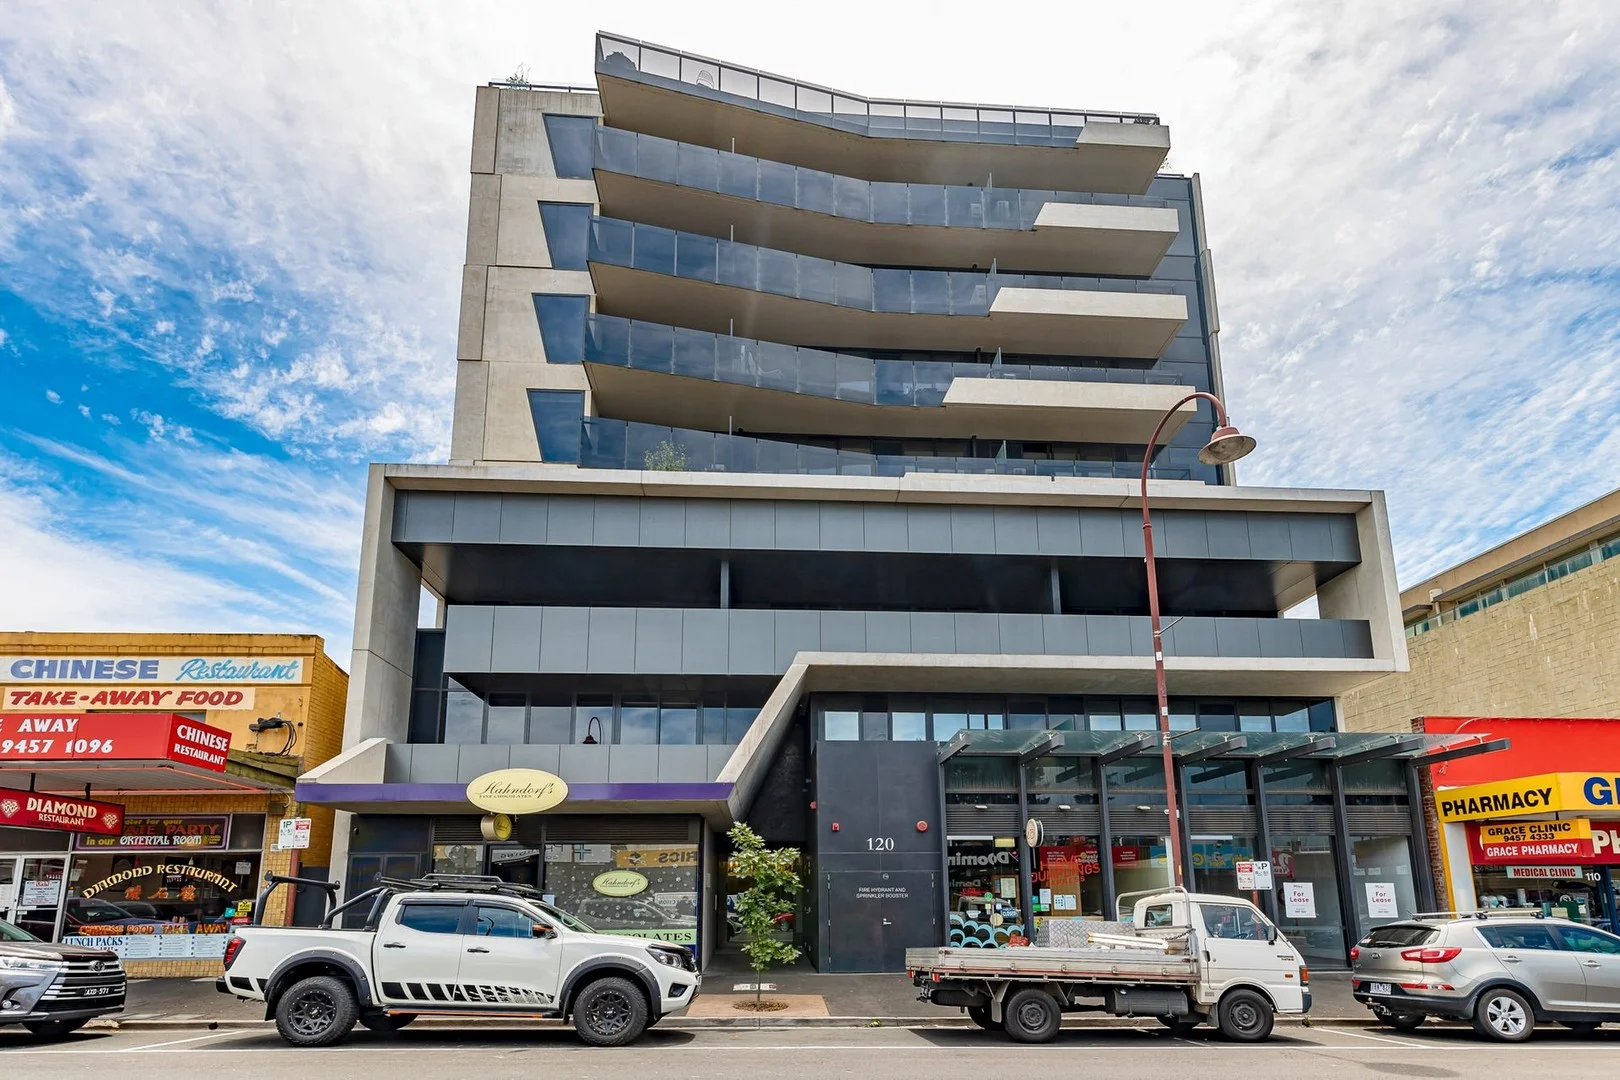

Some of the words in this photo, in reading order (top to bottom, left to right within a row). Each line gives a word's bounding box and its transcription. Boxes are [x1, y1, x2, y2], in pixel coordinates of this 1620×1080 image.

[10, 659, 159, 680] CHINESE
[175, 658, 299, 681] Restaurant
[10, 690, 173, 706] TAKE-AWAY
[175, 690, 244, 706] FOOD
[17, 718, 79, 733] AWAY
[176, 724, 229, 752] CHINESE
[1, 739, 54, 754] 9457
[65, 739, 114, 754] 1096
[173, 743, 225, 766] RESTAURANT
[474, 781, 554, 799] Hahndorf's
[26, 797, 98, 819] DIAMOND
[1441, 787, 1553, 817] PHARMACY
[38, 813, 85, 826] RESTAURANT
[163, 818, 183, 827] your
[165, 824, 220, 836] PARTY
[1487, 825, 1526, 837] GRACE
[1529, 822, 1571, 834] CLINIC
[86, 836, 97, 846] in
[98, 838, 115, 846] our
[120, 835, 170, 845] ORIENTAL
[866, 837, 895, 851] 120
[1503, 834, 1527, 843] 9457
[1529, 832, 1555, 841] 4333
[1486, 845, 1519, 857] GRACE
[1521, 842, 1579, 856] PHARMACY
[156, 864, 238, 893] RESTAURANT
[1513, 867, 1548, 877] MEDICAL
[1550, 867, 1576, 877] CLINIC
[1585, 872, 1601, 881] 110
[162, 924, 190, 935] TAKE
[195, 923, 229, 934] AWAY
[96, 937, 123, 946] PACKS
